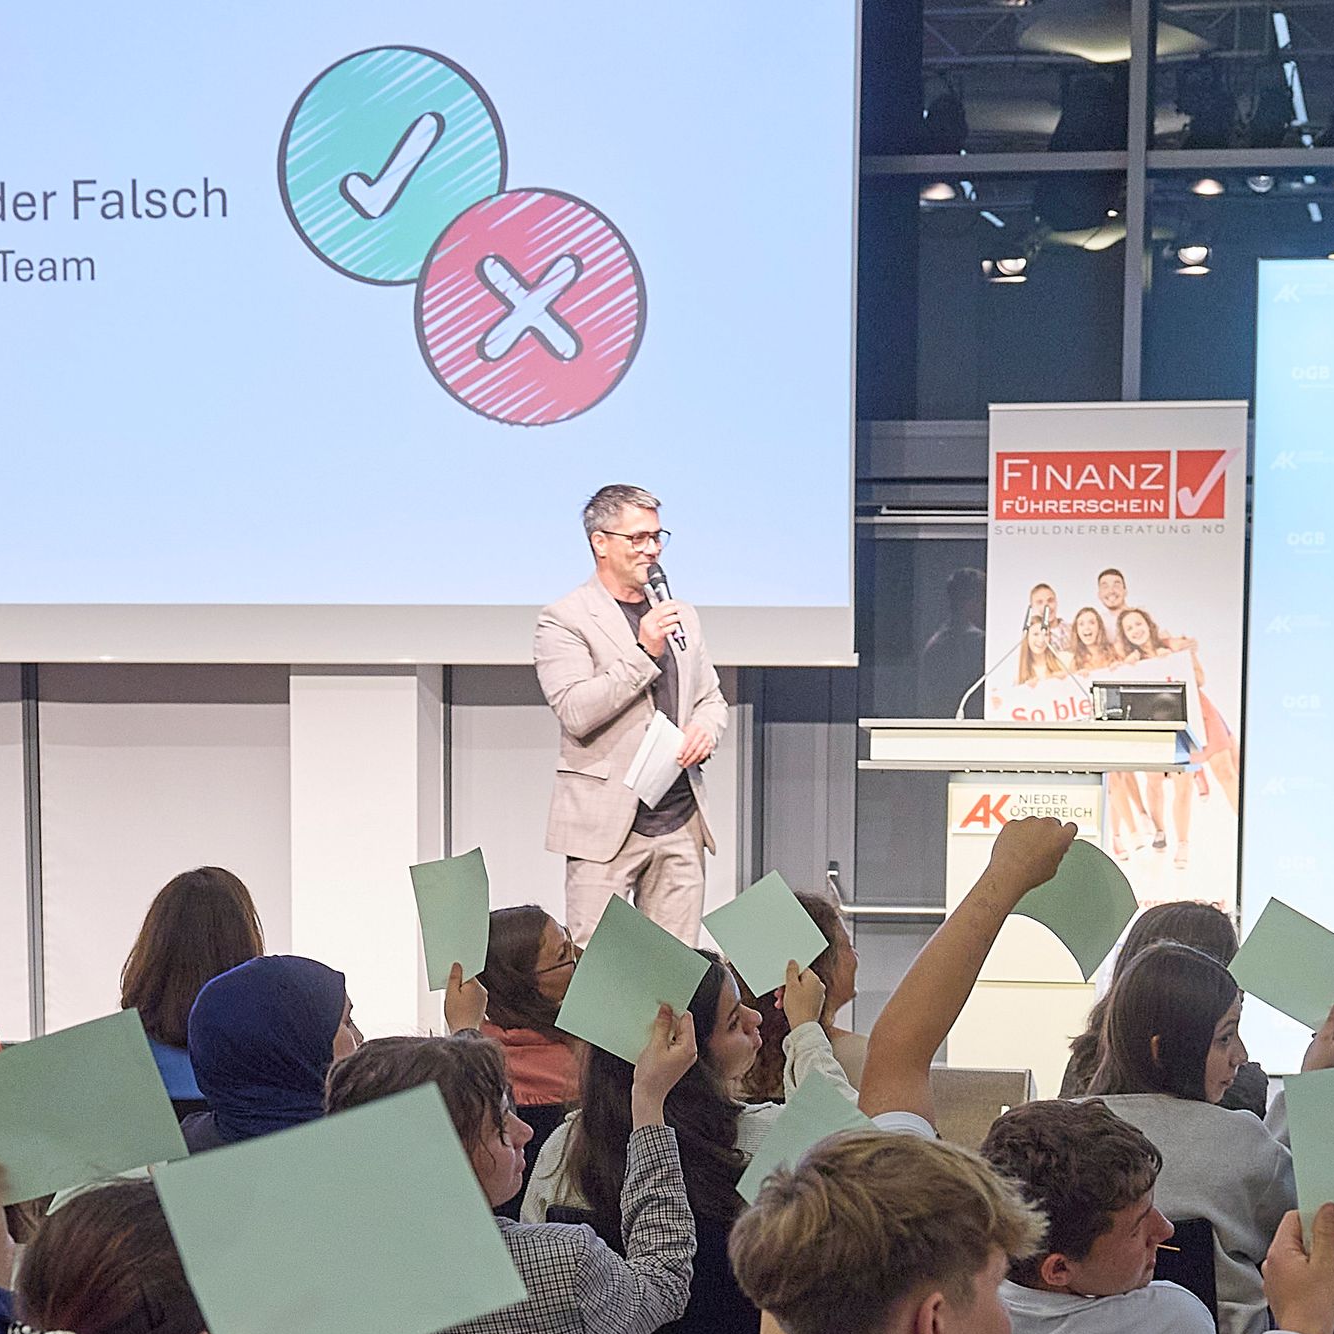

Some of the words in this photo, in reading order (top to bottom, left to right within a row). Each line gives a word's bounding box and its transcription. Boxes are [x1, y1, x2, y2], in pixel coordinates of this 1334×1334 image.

[72, 177, 228, 220] Falsch
[1002, 458, 1165, 491] FINANZ
[1002, 496, 1164, 514] FÜHRERSCHEIN
[994, 524, 1191, 536] SCHULDNERBERATUNG
[1202, 523, 1226, 535] NÖ
[1011, 706, 1045, 720] So
[1018, 794, 1068, 805] NIEDER
[959, 794, 1012, 828] AK
[1009, 804, 1093, 818] ÖSTERREICH
